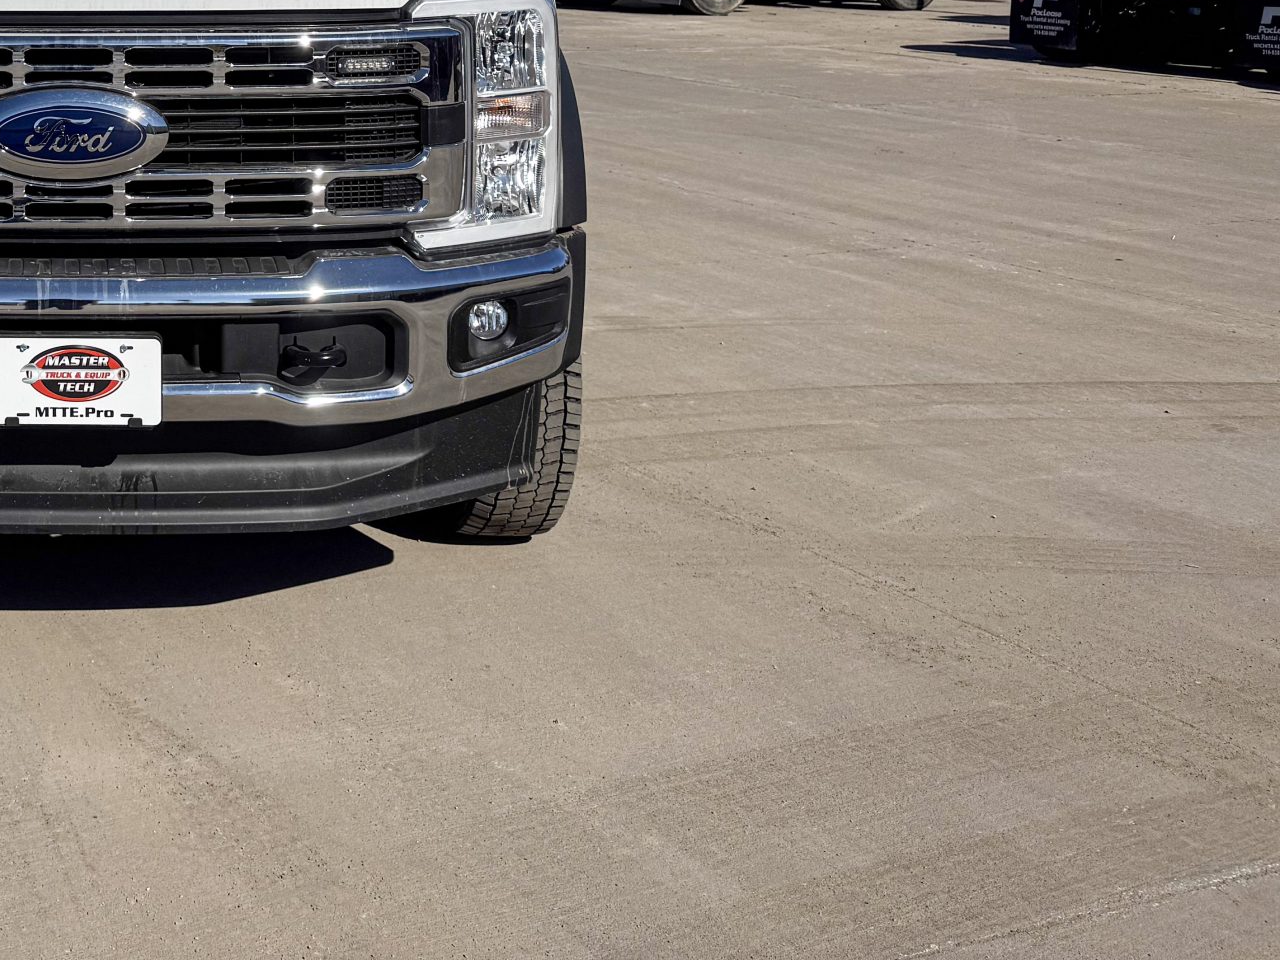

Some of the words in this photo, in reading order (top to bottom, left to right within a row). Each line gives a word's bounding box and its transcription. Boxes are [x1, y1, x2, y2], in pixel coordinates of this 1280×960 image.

[24, 116, 115, 153] Ford
[45, 355, 109, 367] MASTER
[45, 371, 73, 379] TRUCK
[74, 371, 82, 379] &
[84, 371, 111, 379] EQUIP
[57, 382, 95, 393] TECH
[35, 407, 115, 418] MTTE.Pro
